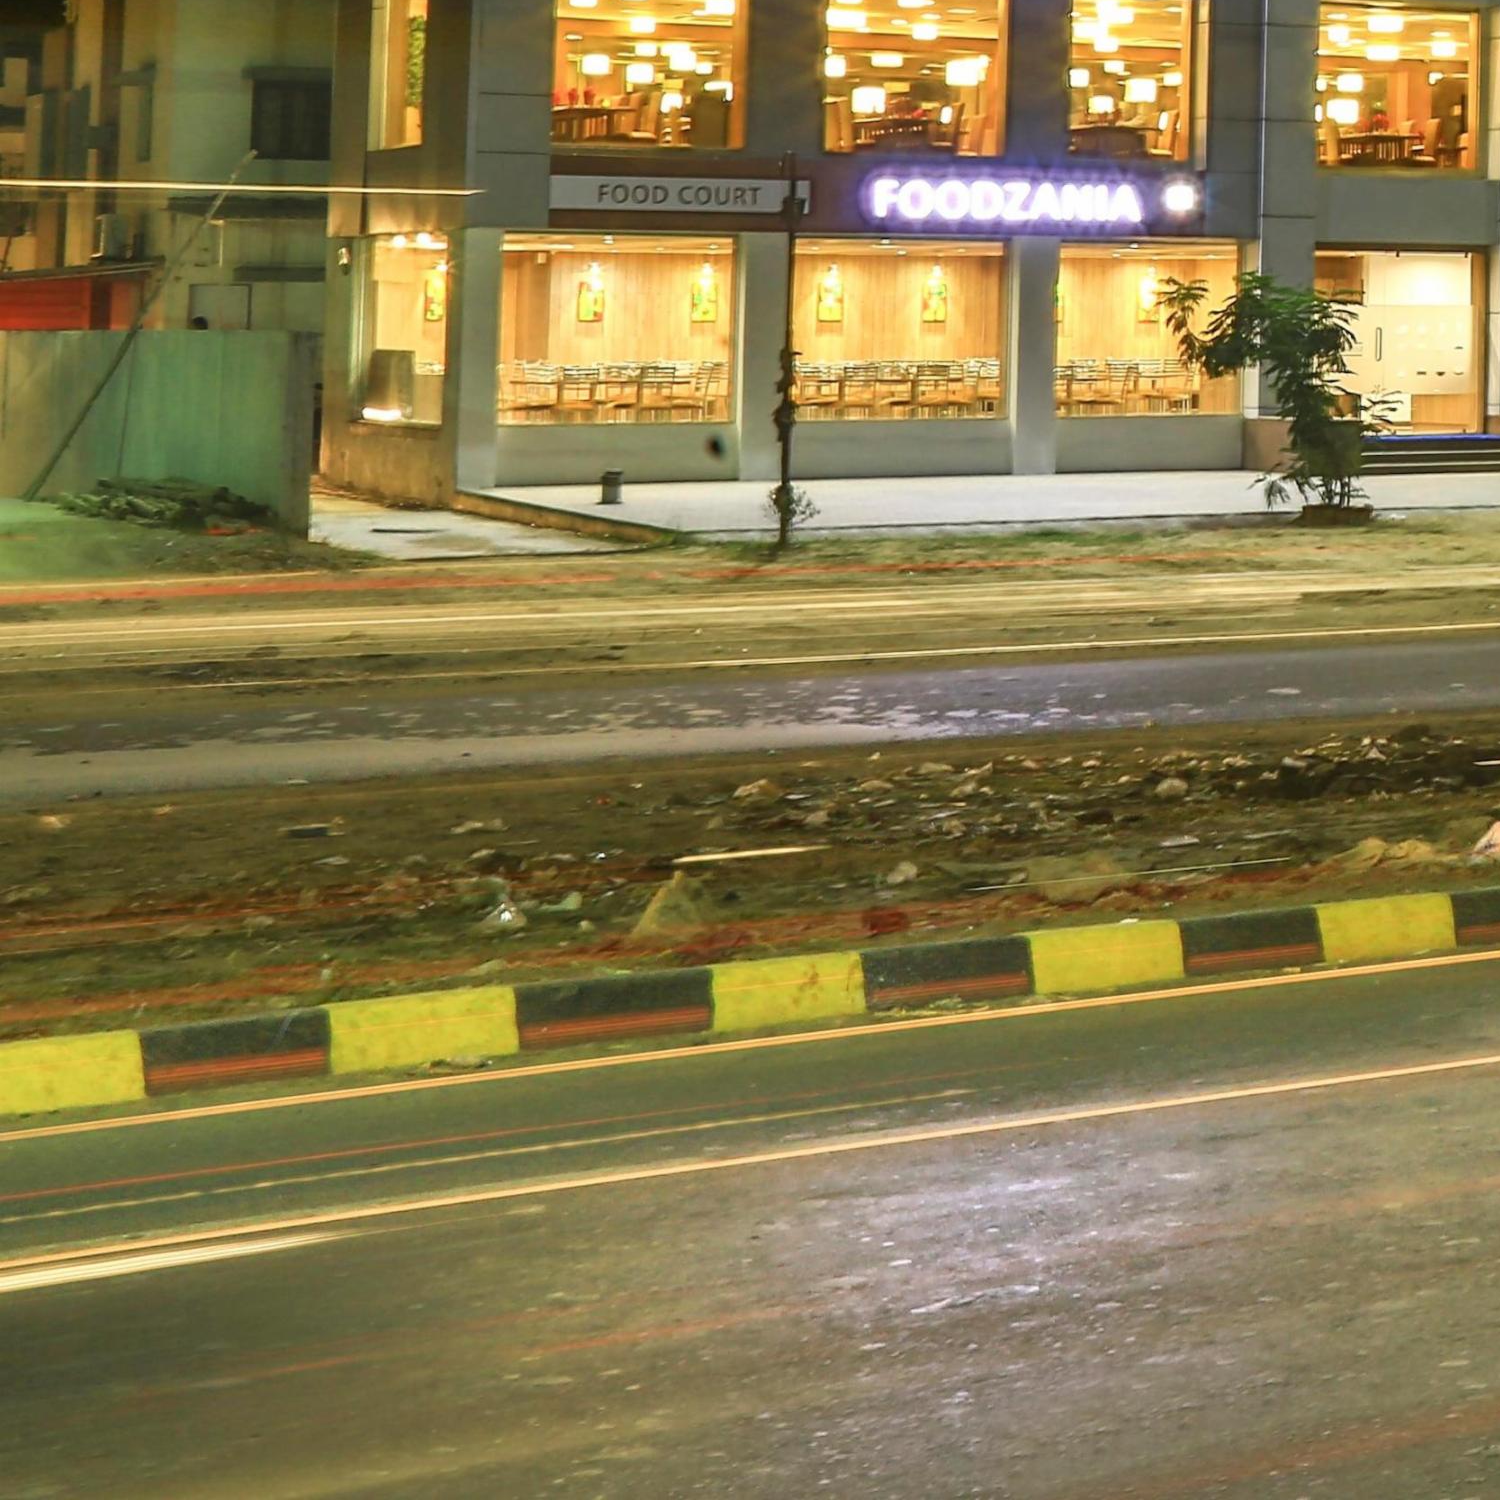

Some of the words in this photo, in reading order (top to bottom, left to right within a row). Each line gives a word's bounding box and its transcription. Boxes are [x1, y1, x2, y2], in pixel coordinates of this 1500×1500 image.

[597, 182, 669, 206] FOOD
[677, 184, 760, 207] COURT
[872, 178, 1143, 222] FOODZANIA
